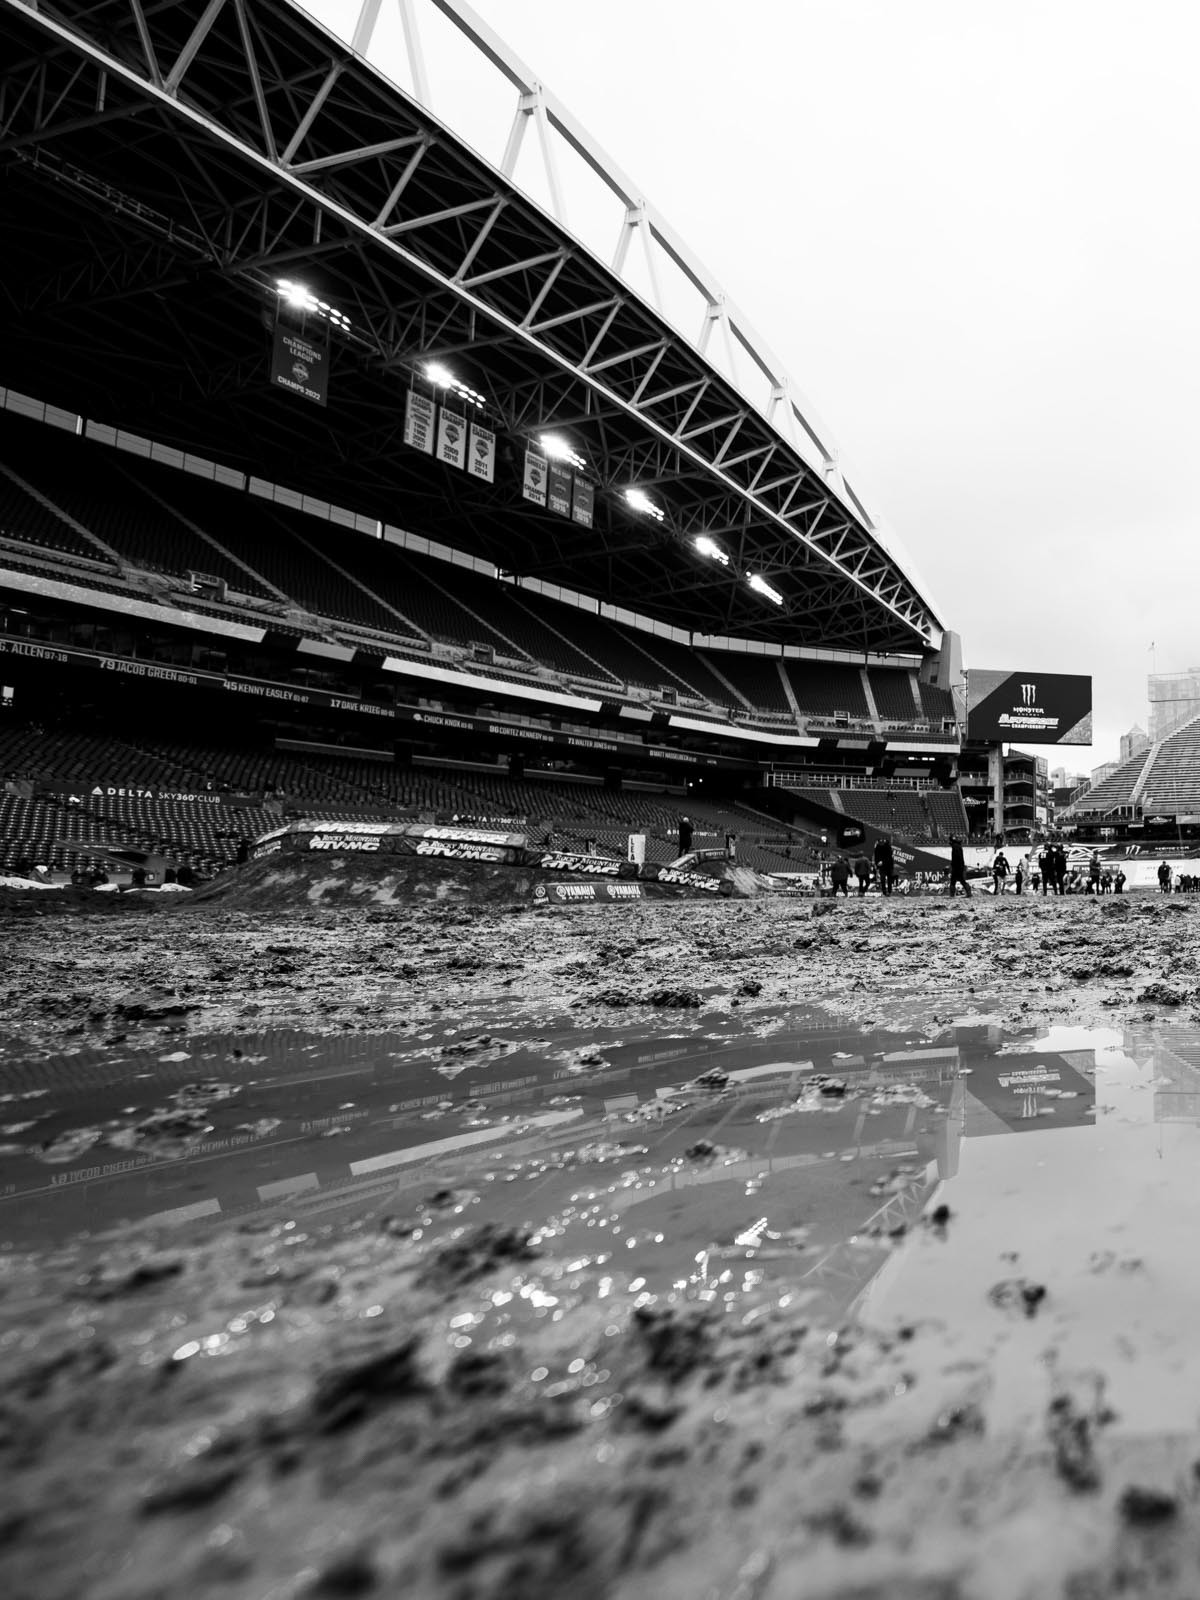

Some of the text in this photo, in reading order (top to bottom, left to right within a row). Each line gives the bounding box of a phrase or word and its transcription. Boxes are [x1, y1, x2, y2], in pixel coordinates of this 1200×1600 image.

[283, 336, 321, 360] CHAMPIONS
[290, 347, 314, 364] LEAGUE
[277, 375, 305, 393] CHAMPS
[12, 643, 44, 659] ALLEN
[44, 652, 68, 662] 97-18
[100, 660, 116, 670] 79
[115, 660, 146, 676] JACOB
[147, 668, 178, 681] GREEN
[223, 680, 238, 691] 45
[238, 683, 265, 696] KENNY
[266, 687, 294, 700] EASLEY
[330, 699, 341, 708] 17
[341, 701, 360, 711] DAVE
[360, 704, 381, 715] KRIEG
[1012, 706, 1045, 714] MONSTER
[423, 715, 444, 725] CHUCK
[444, 719, 461, 728] KNOX
[489, 725, 499, 733] 96
[499, 727, 520, 736] CORTEZ
[520, 730, 543, 740] KENNEDY
[568, 737, 575, 745] 71
[575, 738, 594, 748] WALTER
[107, 787, 153, 799] DELTA
[555, 854, 622, 868] ROCKY MOUNTAIN
[564, 885, 596, 897] YAMAHA
[613, 885, 641, 896] YAMAHA
